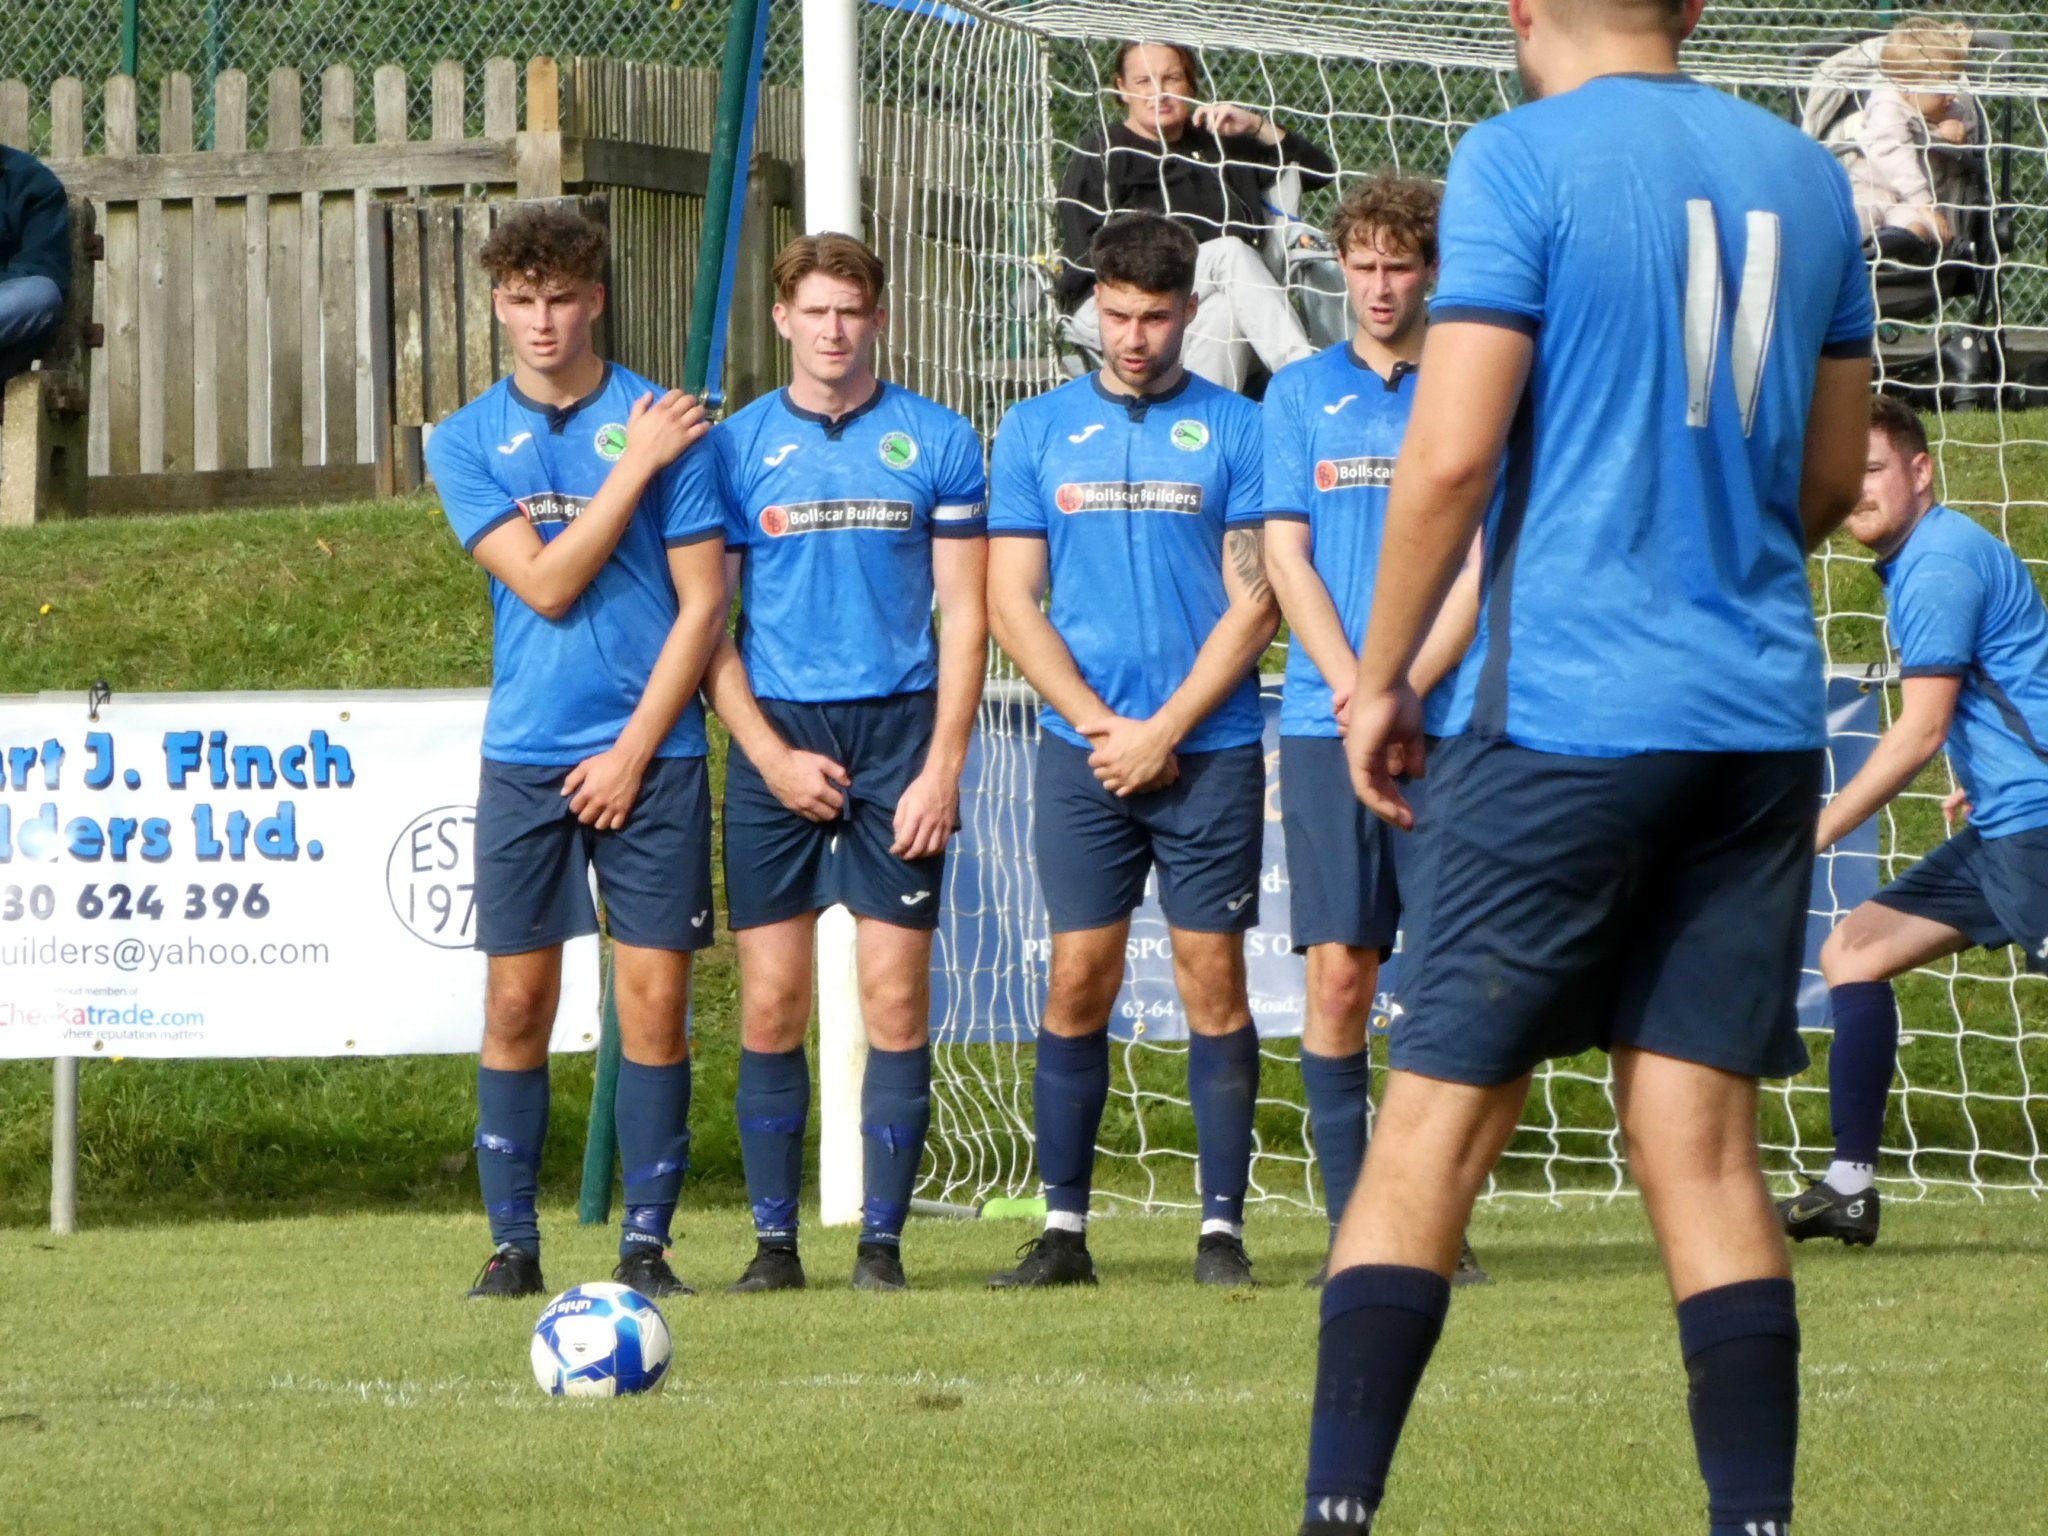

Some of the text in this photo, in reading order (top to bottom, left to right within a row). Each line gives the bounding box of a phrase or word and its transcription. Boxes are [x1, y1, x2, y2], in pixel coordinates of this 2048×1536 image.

[1685, 199, 1780, 438] 11
[1140, 488, 1197, 505] Builders
[790, 506, 908, 525] Bollscar Builders
[0, 730, 356, 792] rt J. Finch
[191, 801, 325, 863] Ltd.
[2, 882, 271, 922] 30 624 396
[2, 935, 329, 972] uilders@yahoo.com
[0, 1003, 204, 1026] hekatrade.com
[1121, 1000, 1174, 1018] 62-64
[97, 1029, 157, 1041] reputation
[625, 1232, 661, 1245] Jom
